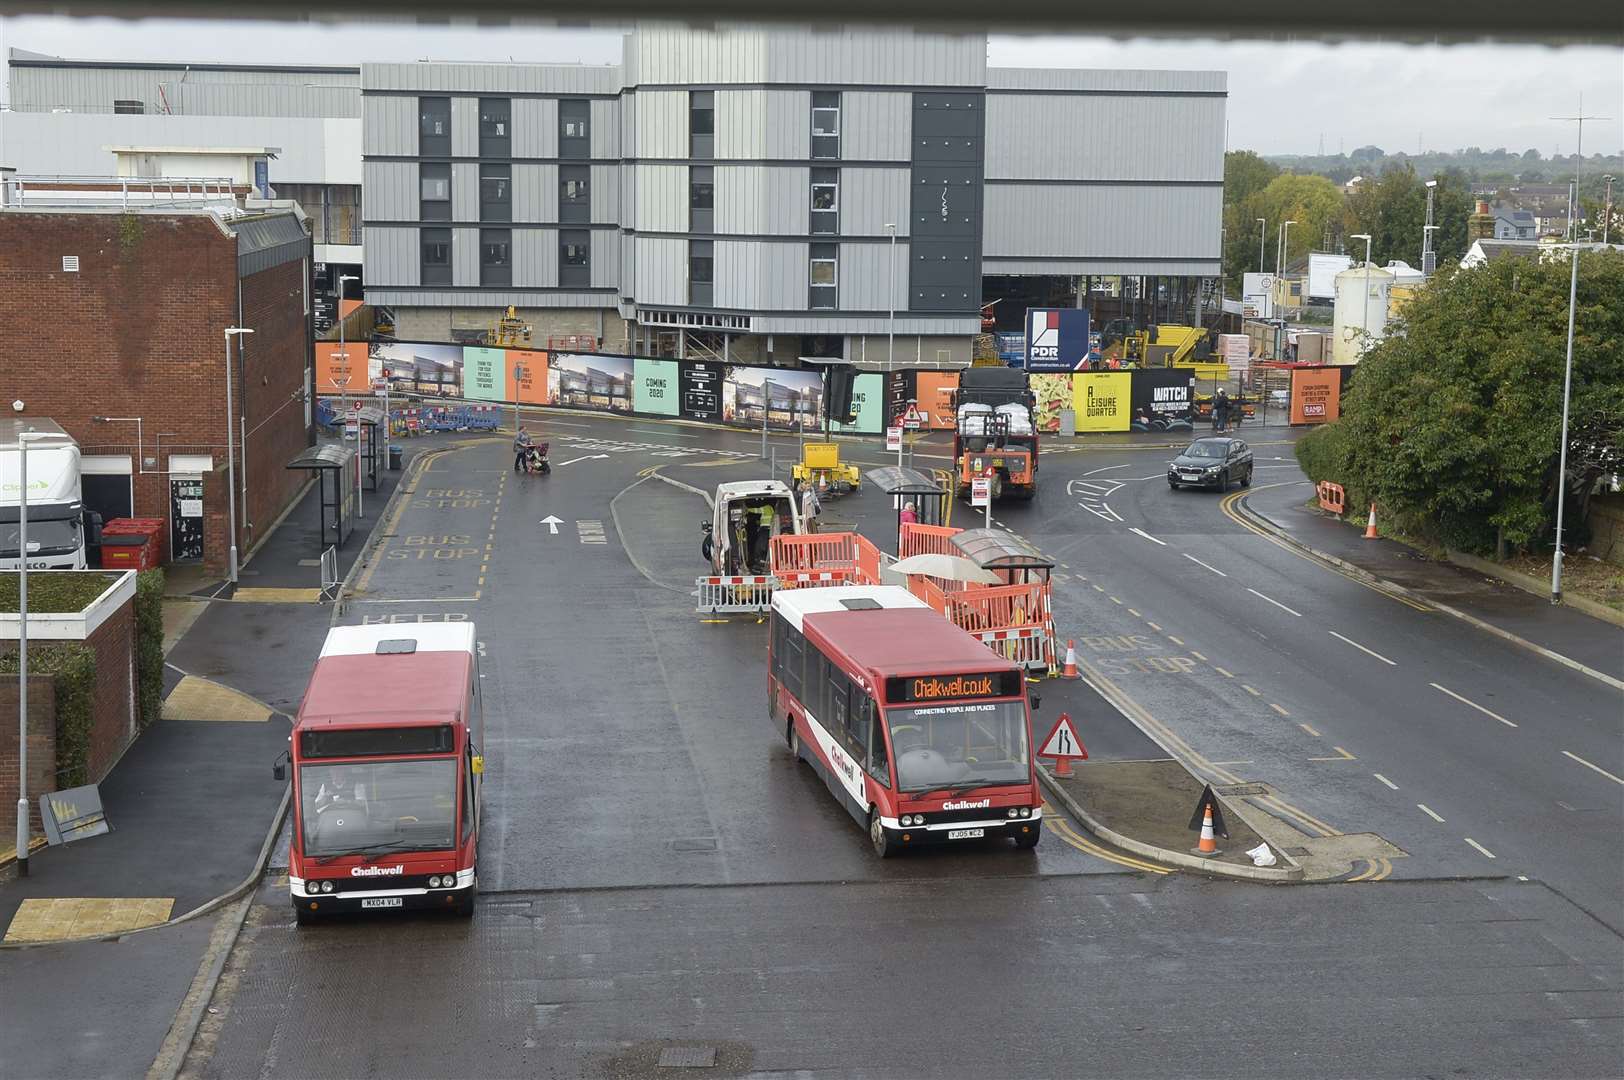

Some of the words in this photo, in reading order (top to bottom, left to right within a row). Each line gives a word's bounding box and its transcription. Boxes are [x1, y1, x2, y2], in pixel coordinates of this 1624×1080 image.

[1031, 347, 1058, 356] PDR
[645, 378, 667, 388] COMING
[649, 389, 664, 398] 2020
[1087, 386, 1094, 397] A
[1153, 387, 1187, 401] WATCH
[853, 393, 866, 402] ING
[1087, 398, 1117, 407] LEISURE
[851, 403, 861, 413] 20
[1087, 408, 1117, 417] QUARTER
[986, 468, 992, 476] 4
[425, 489, 483, 498] BUS
[413, 499, 491, 509] STOP
[404, 535, 472, 545] BUS
[387, 548, 479, 560] STOP
[1080, 635, 1163, 651] BUS
[1097, 657, 1197, 675] STOP
[914, 677, 992, 698] Chalkwell.co.uk
[914, 707, 945, 715] CONNECTING
[942, 799, 990, 810] Chalkwell
[951, 830, 968, 838] YJ05
[351, 865, 404, 877] Chalkwell
[366, 898, 385, 907] MX04
[387, 898, 401, 906] VLR
